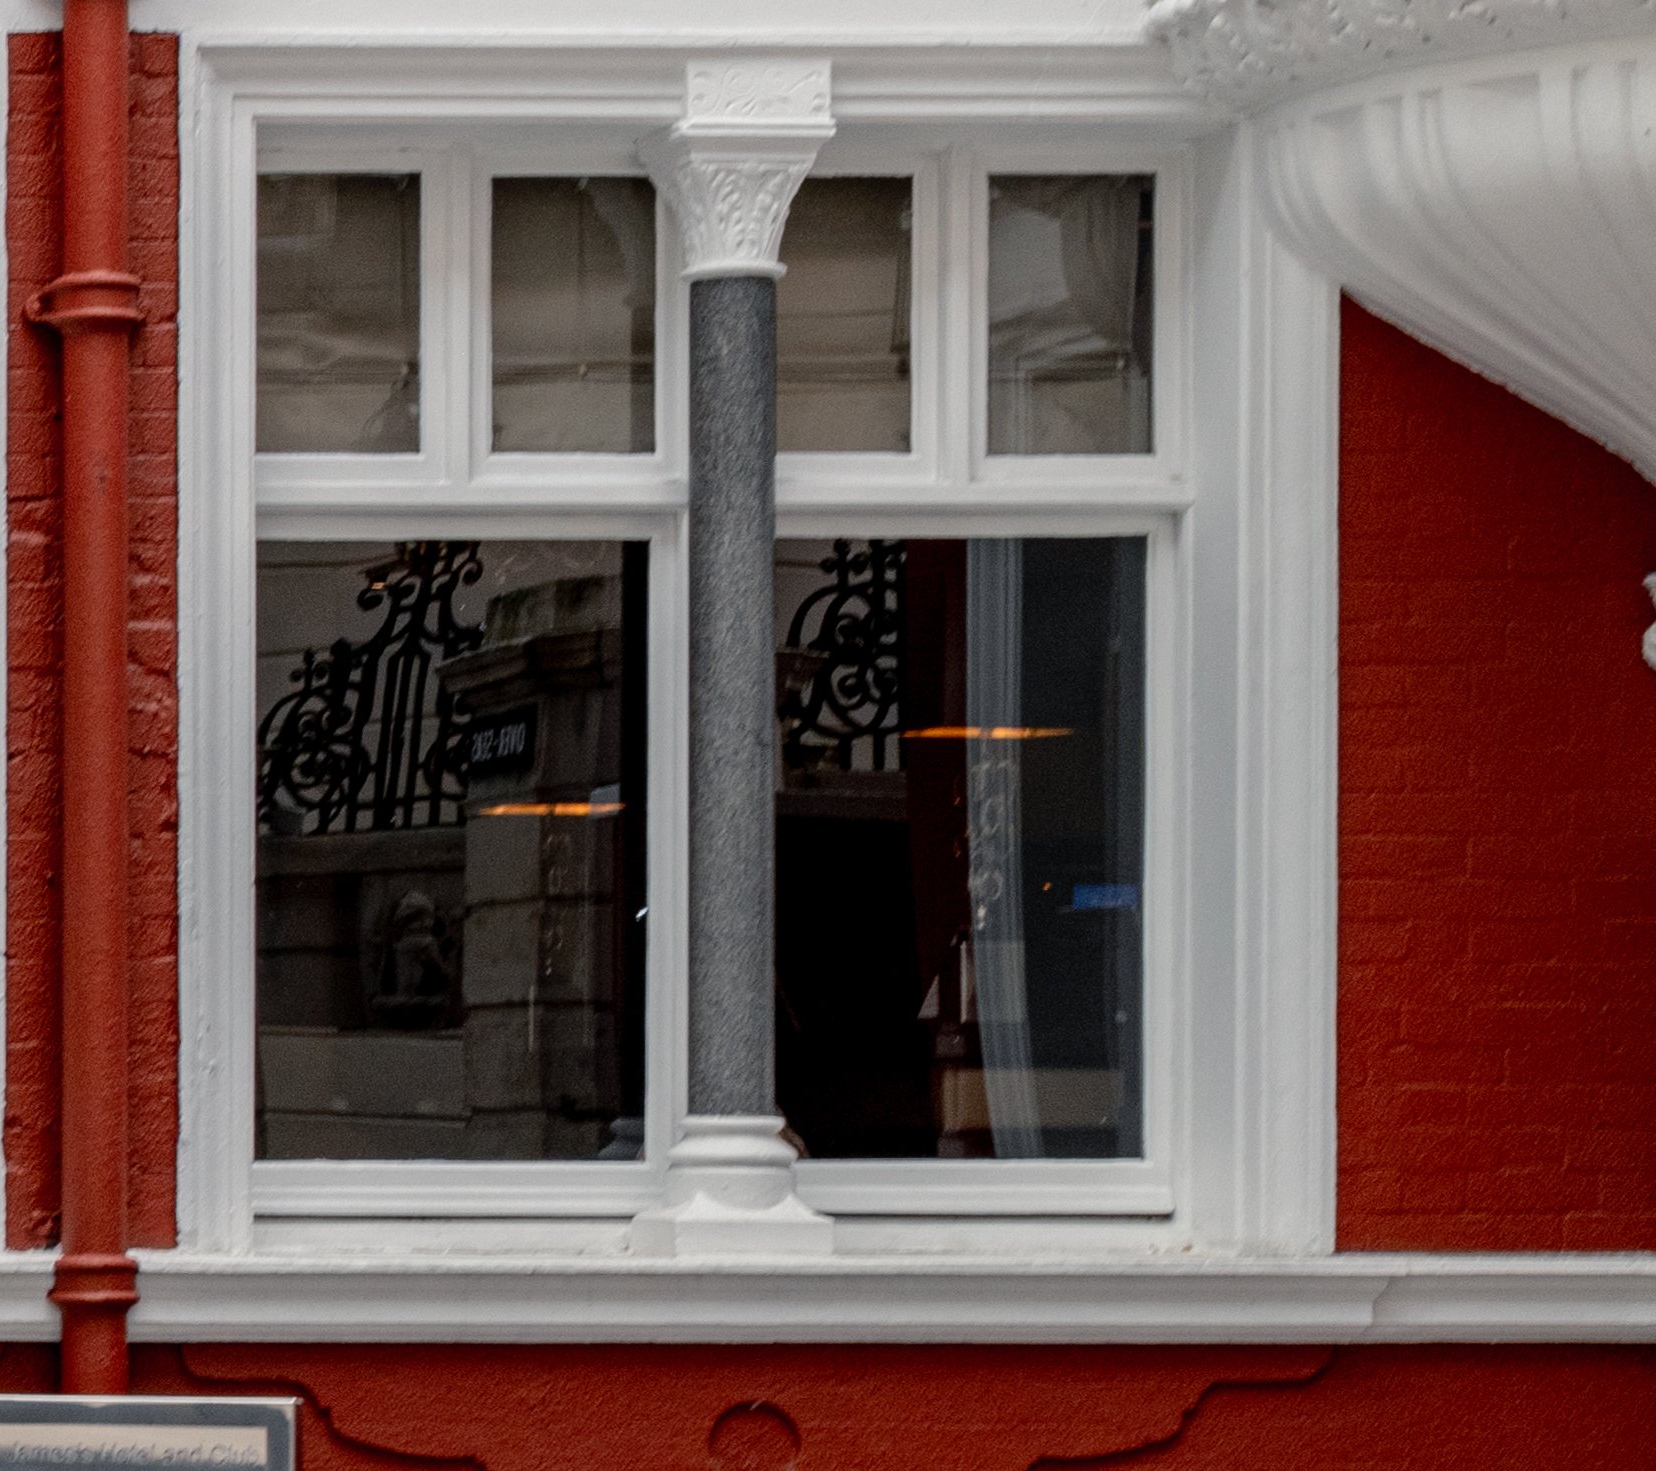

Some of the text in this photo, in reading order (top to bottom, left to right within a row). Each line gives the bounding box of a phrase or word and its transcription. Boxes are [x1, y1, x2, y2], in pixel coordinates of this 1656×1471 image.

[98, 1442, 155, 1465] Hotel
[160, 1443, 203, 1466] and
[209, 1443, 259, 1466] Club
